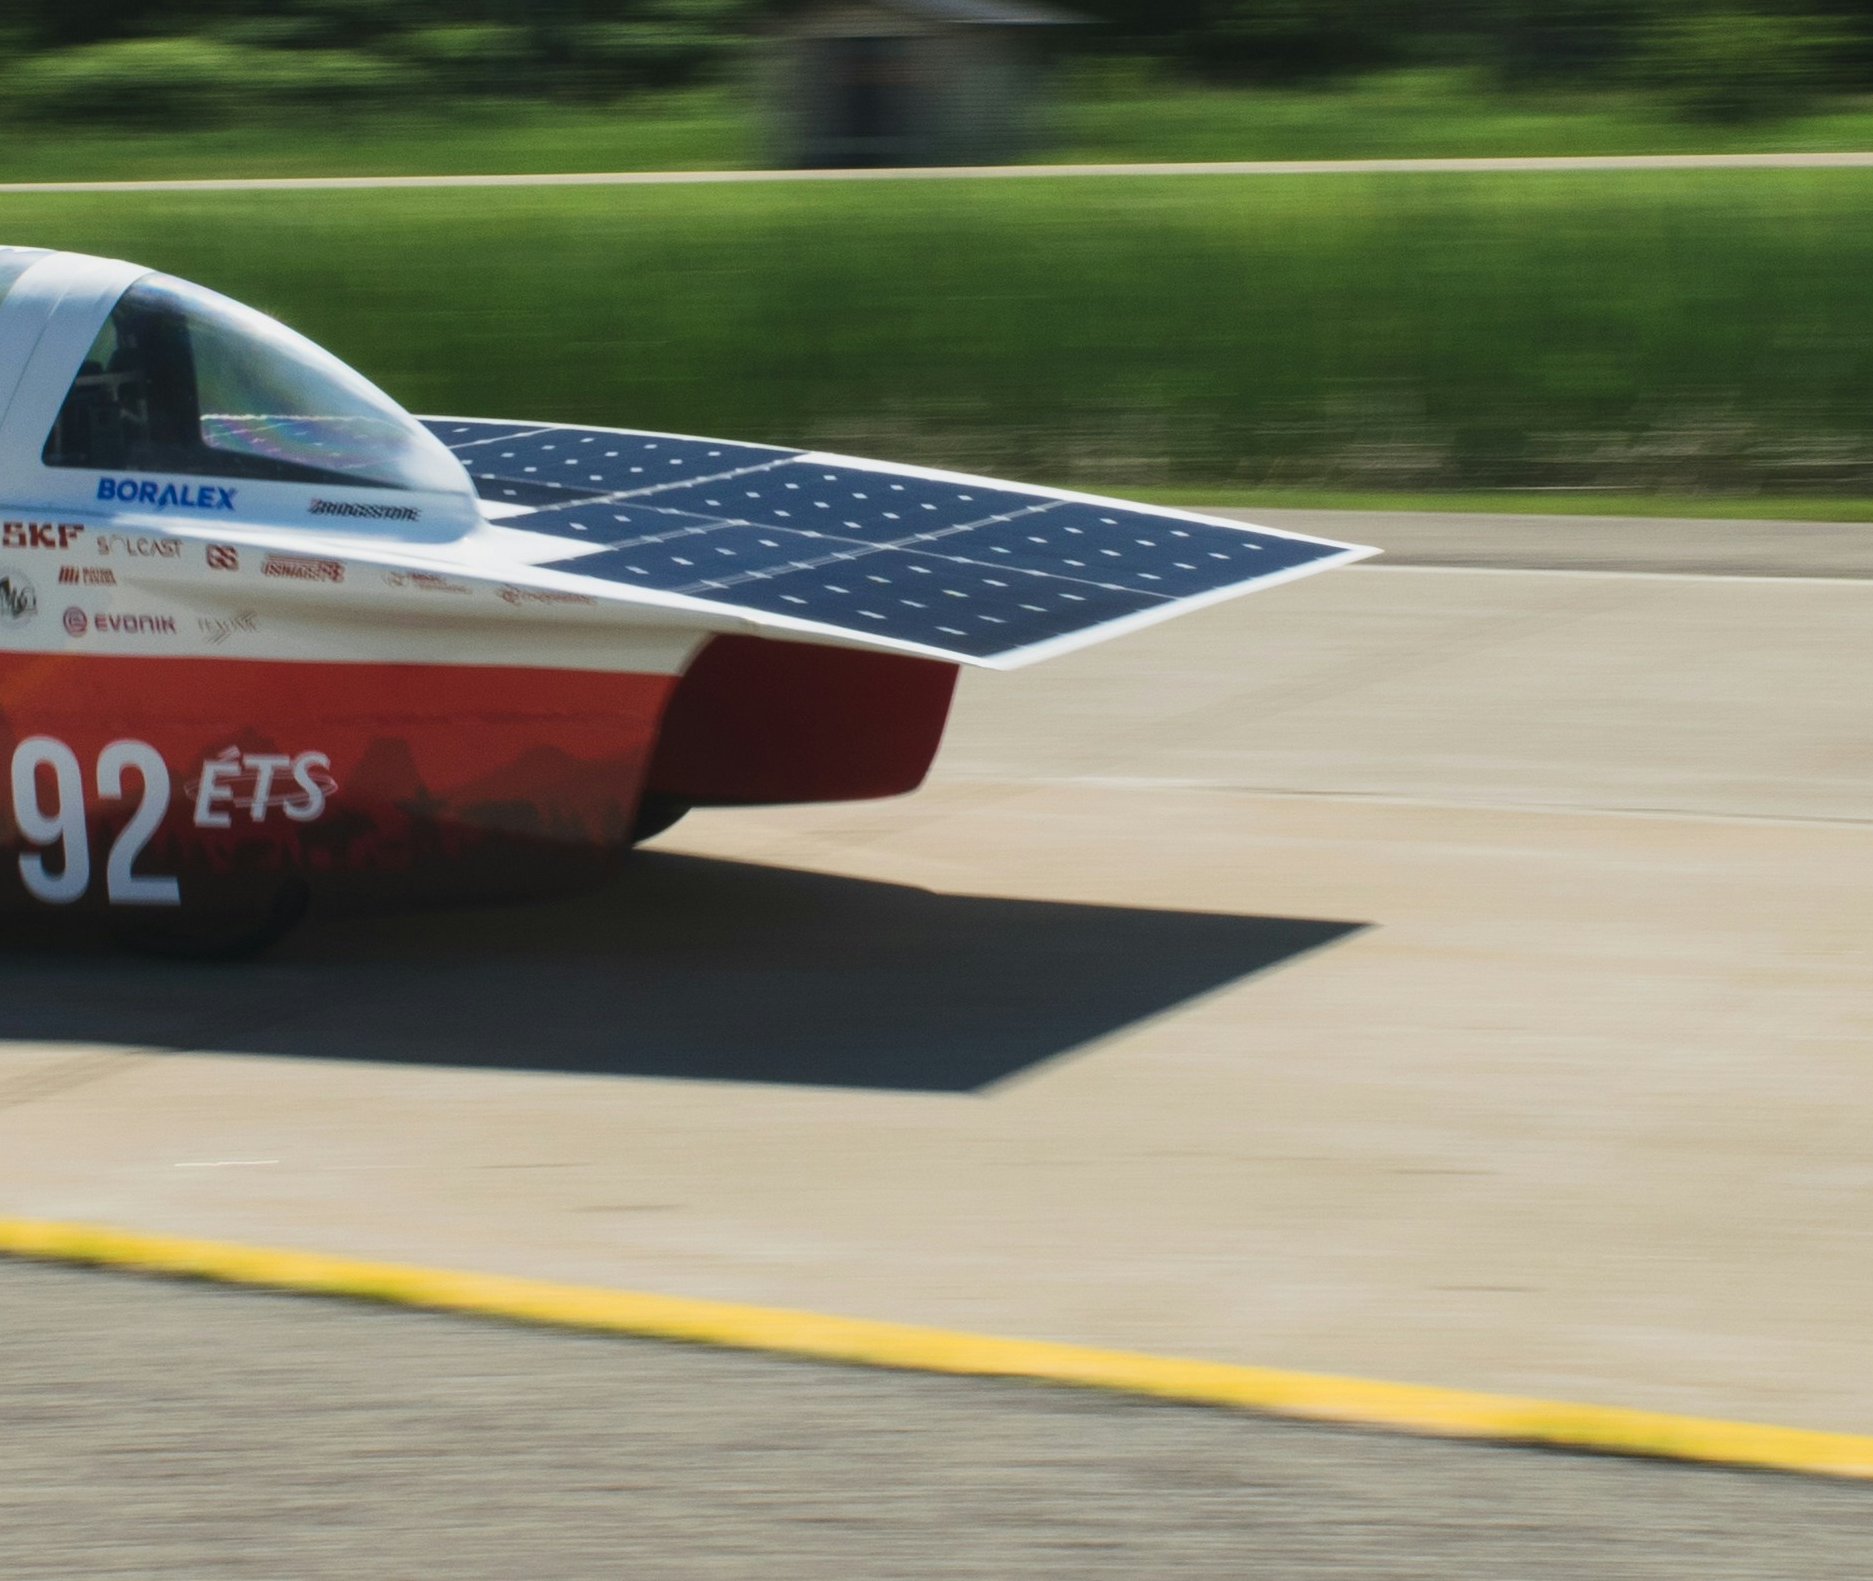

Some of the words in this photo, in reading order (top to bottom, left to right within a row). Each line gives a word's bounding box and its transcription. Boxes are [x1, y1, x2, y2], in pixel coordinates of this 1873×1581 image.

[96, 477, 237, 511] BORALEX
[2, 522, 84, 549] SKF
[93, 612, 177, 634] EVONIK
[11, 735, 182, 906] 92
[193, 744, 332, 829] ÉTS
